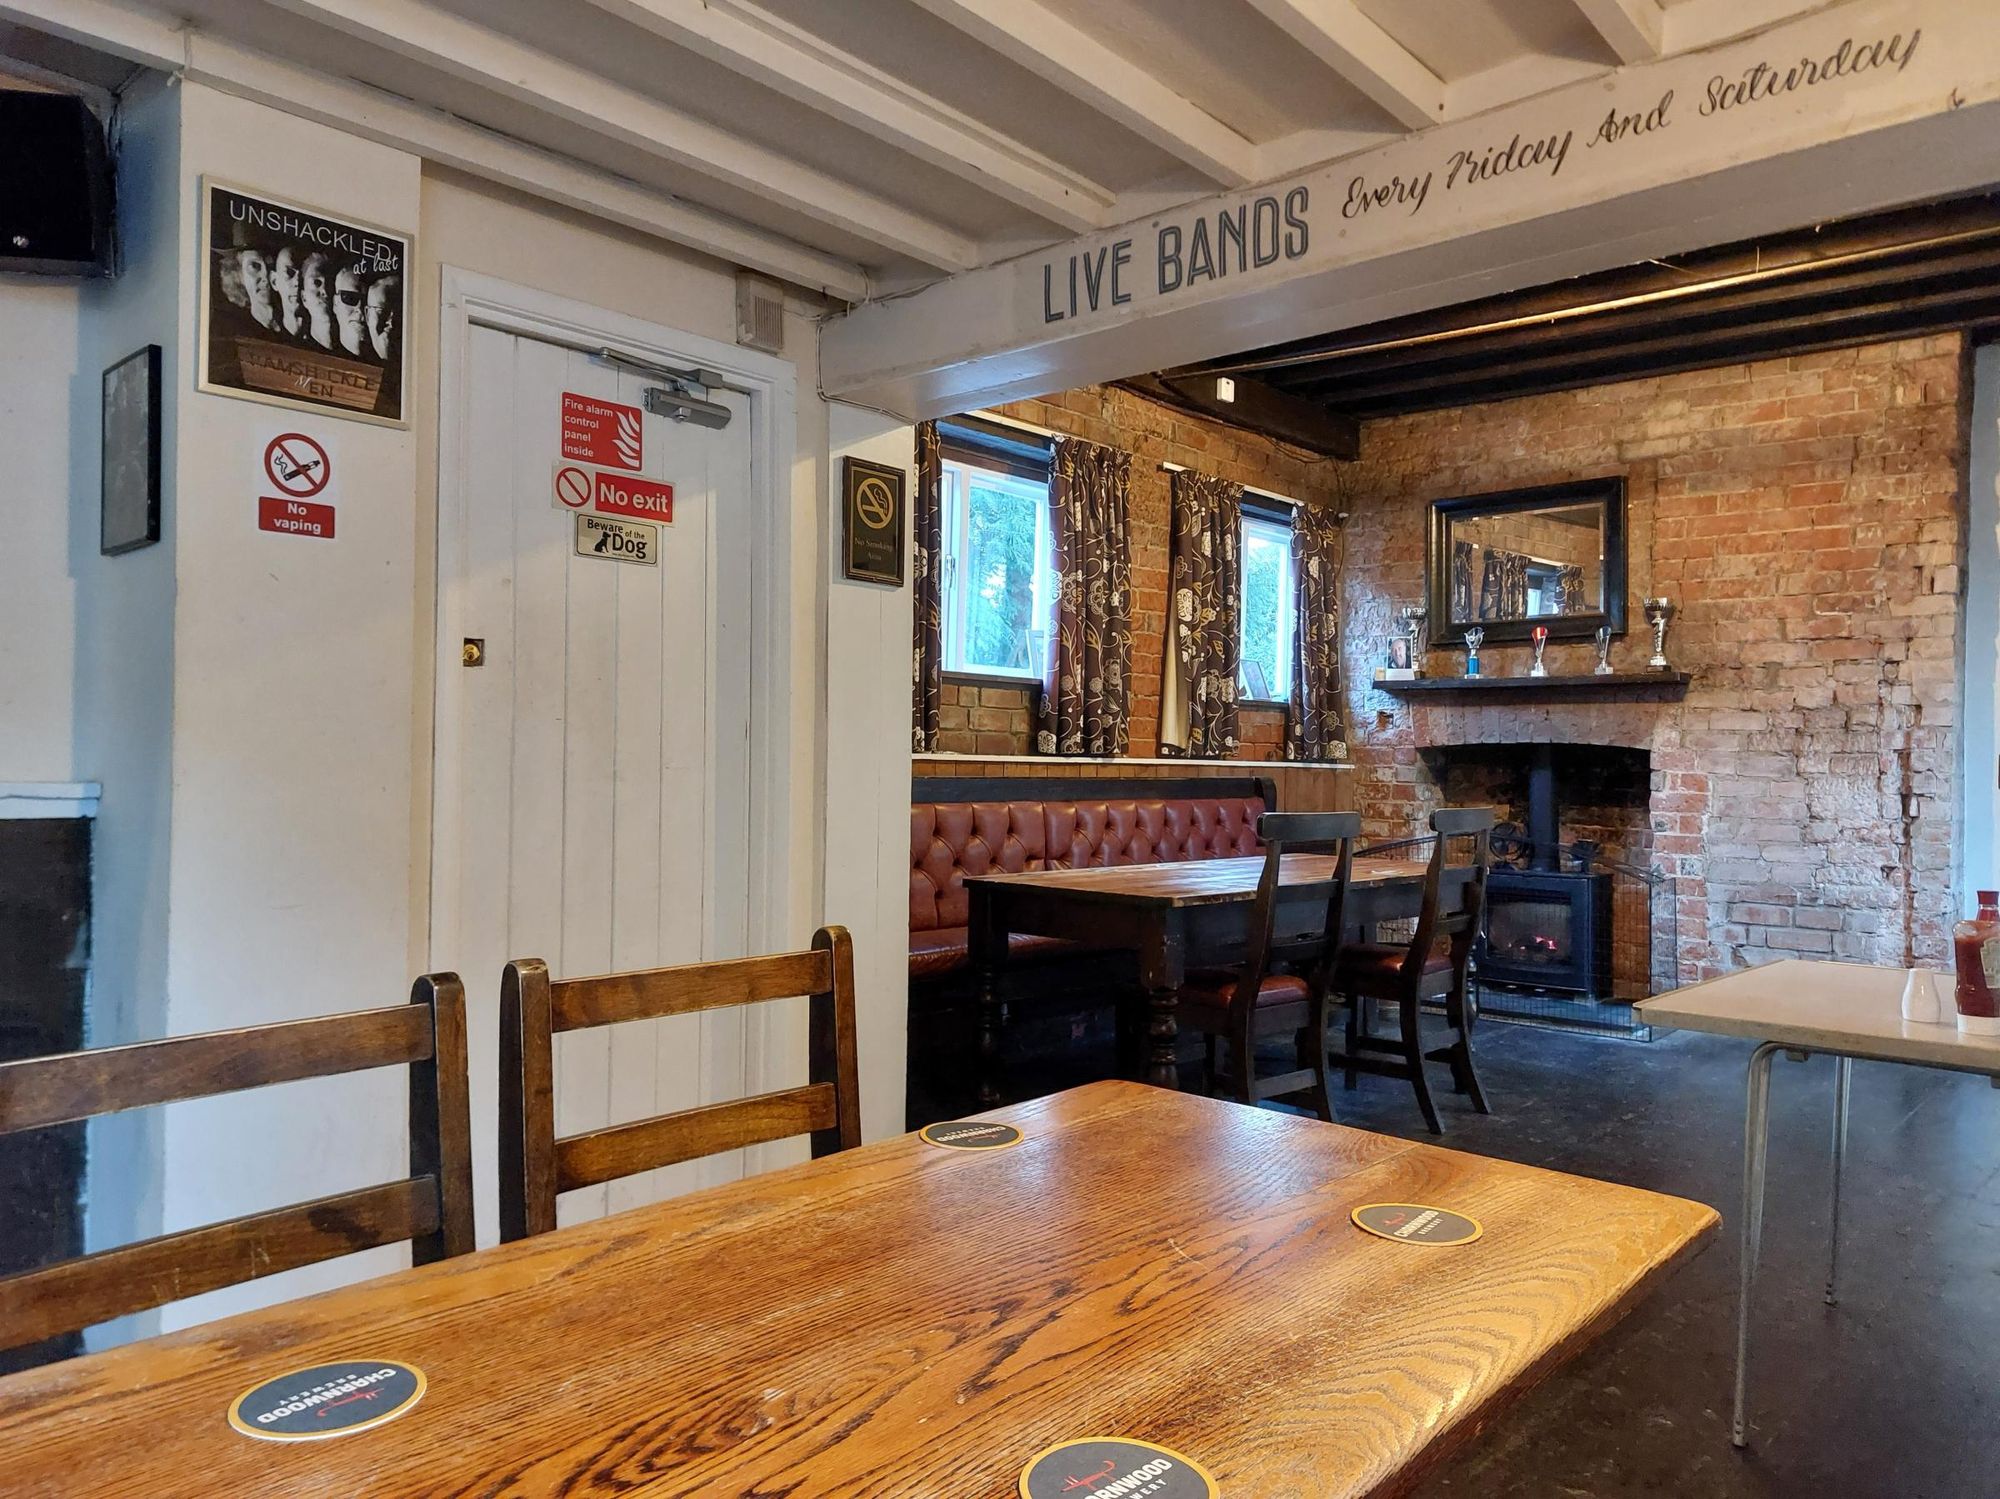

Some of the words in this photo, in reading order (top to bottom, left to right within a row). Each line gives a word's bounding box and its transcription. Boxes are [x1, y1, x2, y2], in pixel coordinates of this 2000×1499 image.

[1044, 239, 1133, 324] LIVE
[1158, 186, 1310, 295] BANDS
[1341, 171, 1433, 218] Every
[1586, 88, 1675, 148] And
[1699, 29, 1921, 116] Saturday
[229, 199, 392, 262] UNSHACKLED
[353, 258, 367, 275] at
[373, 252, 400, 273] last
[564, 398, 584, 411] Fire
[585, 404, 613, 418] alarm
[564, 415, 599, 429] control
[564, 429, 591, 442] panel
[564, 443, 594, 457] inside
[600, 482, 628, 506] No
[632, 492, 669, 513] exit
[287, 502, 307, 516] No
[273, 518, 321, 535] vaping
[587, 518, 624, 533] Beware
[625, 530, 633, 538] of
[634, 531, 645, 539] the
[612, 532, 647, 559] Dog
[257, 1368, 397, 1424] CHARNWOOD
[278, 1374, 358, 1406] BREWERY
